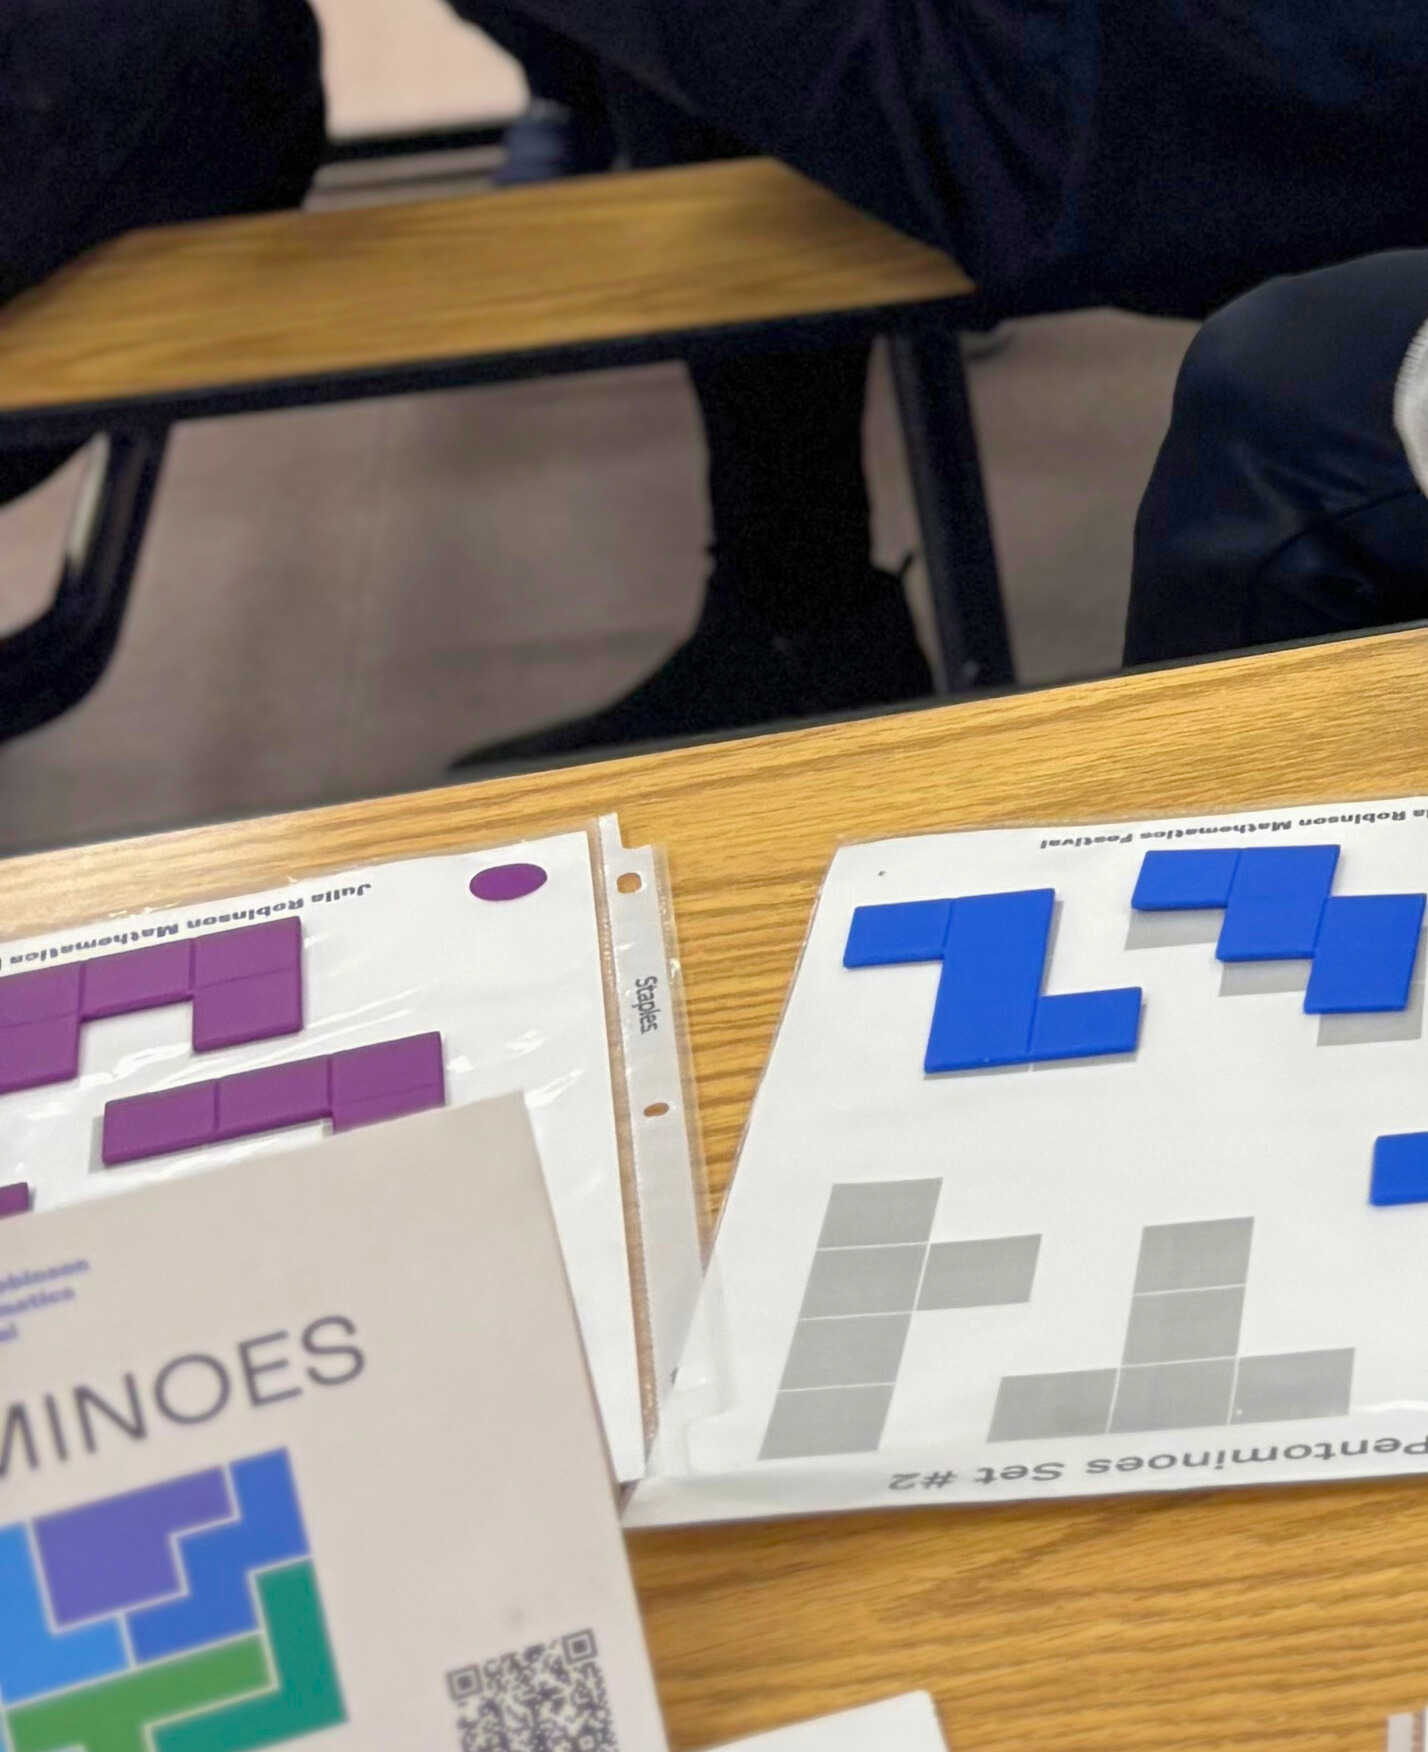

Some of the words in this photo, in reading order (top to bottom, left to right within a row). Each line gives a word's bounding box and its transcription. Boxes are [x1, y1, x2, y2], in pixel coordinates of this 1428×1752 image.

[1299, 809, 1407, 828] Robinson
[310, 882, 372, 903] Julia
[186, 897, 305, 930] Robinson
[10, 922, 179, 965] Mathematics
[631, 975, 661, 1035] Staples
[0, 1314, 367, 1480] MINOES
[887, 1469, 957, 1491] #2
[974, 1460, 1066, 1484] Set
